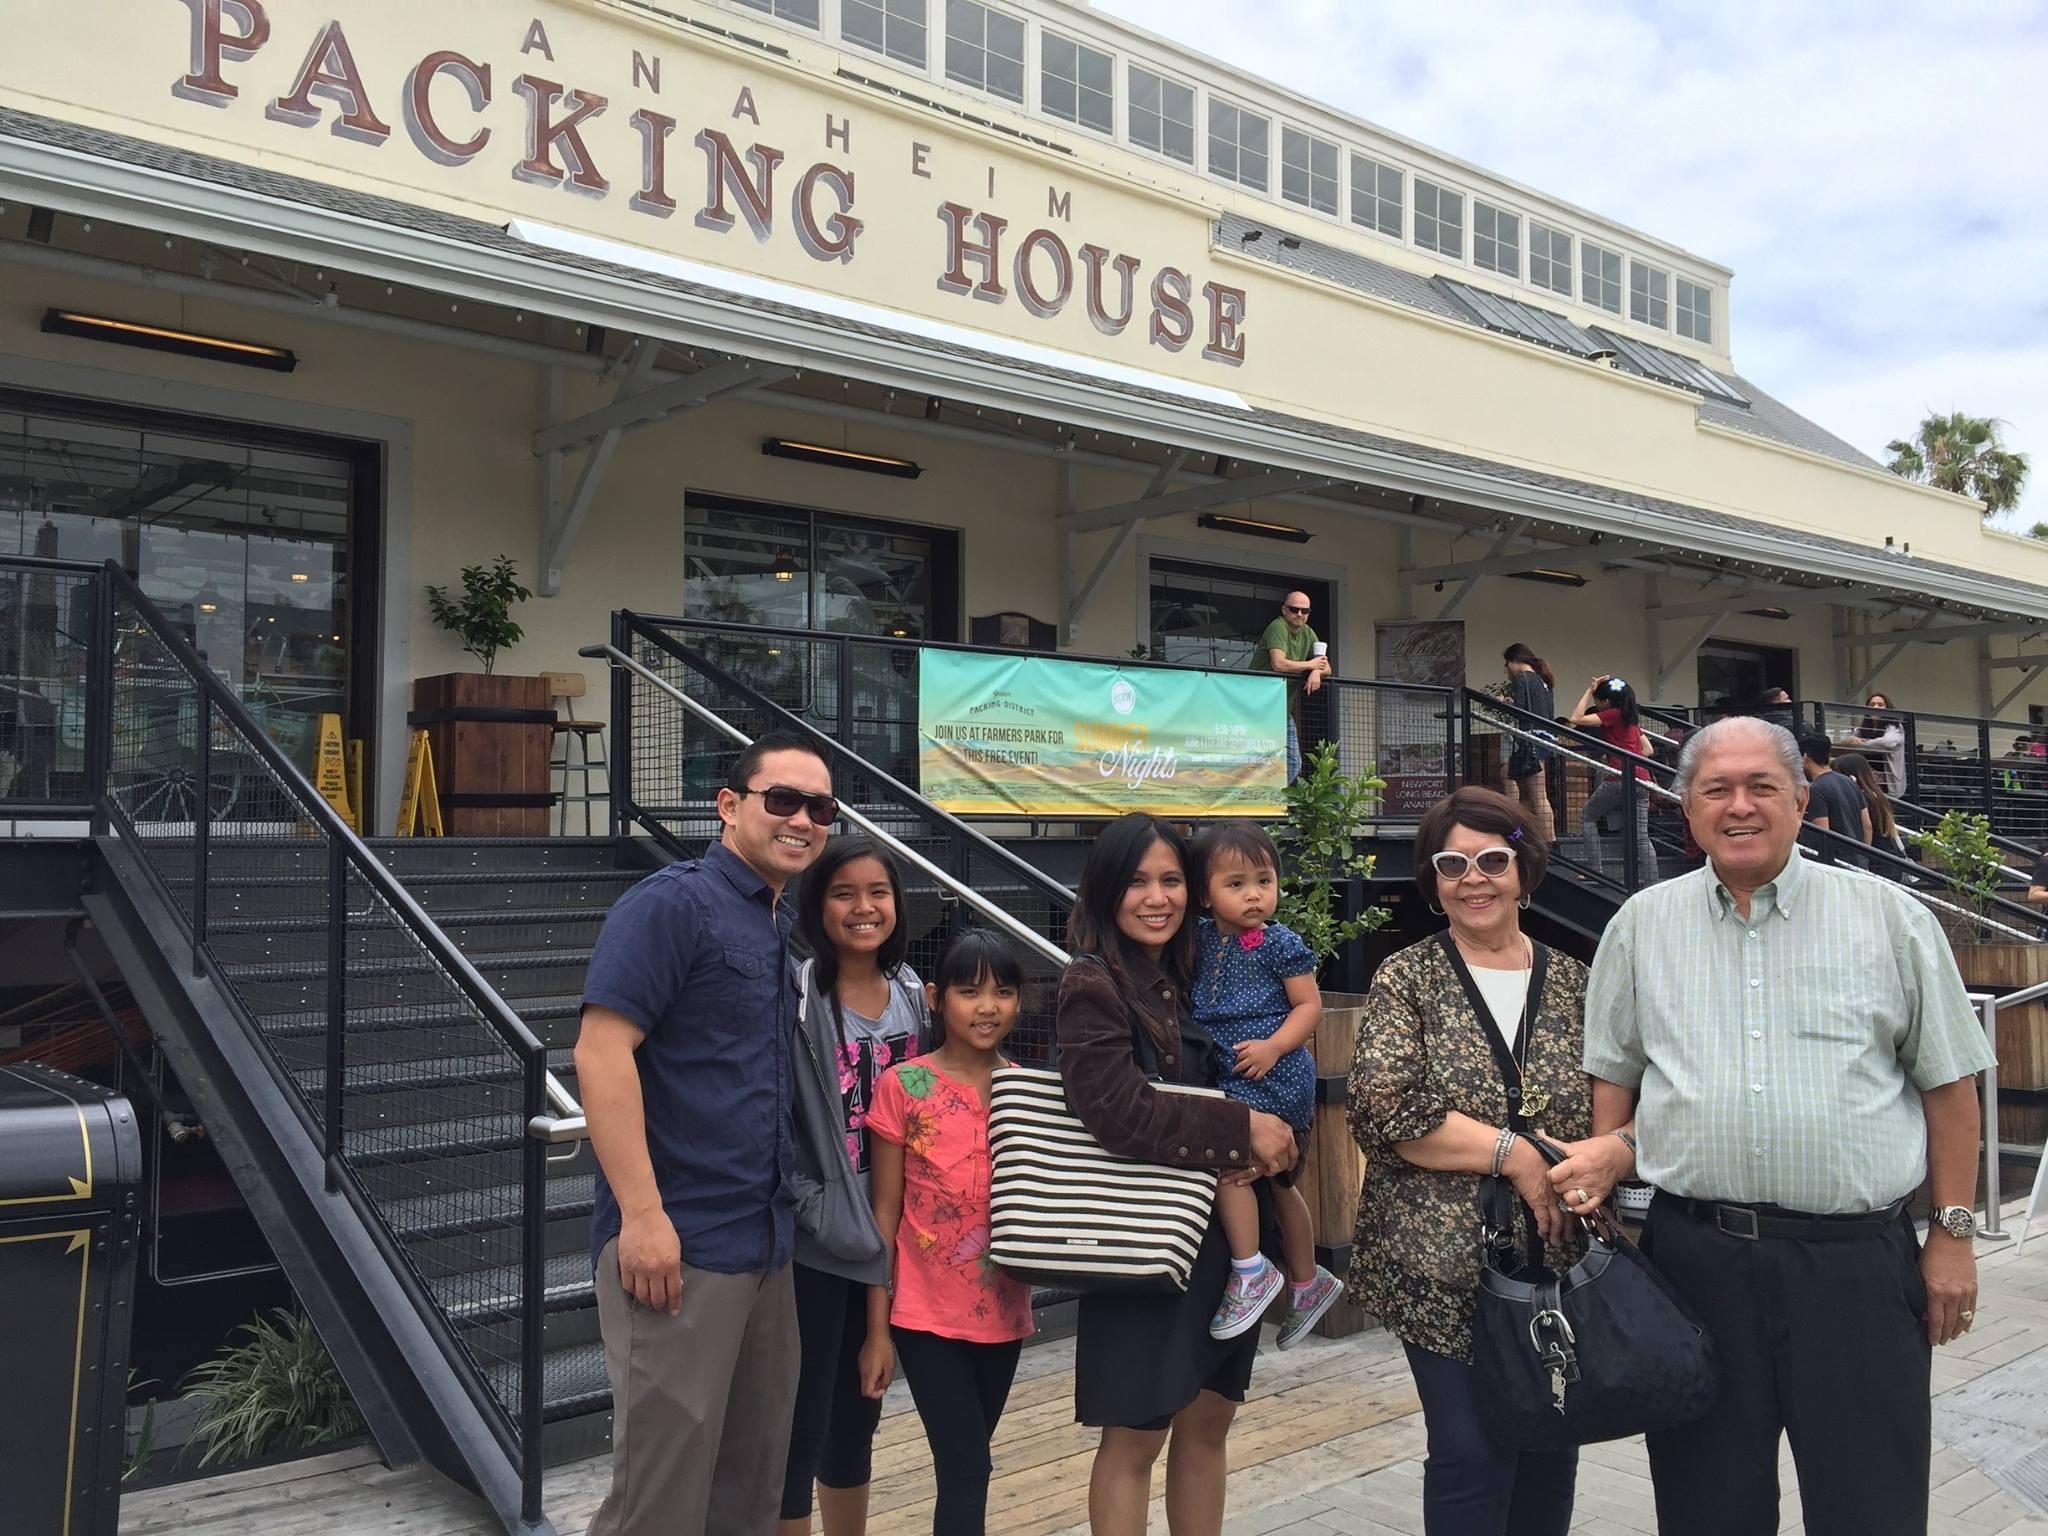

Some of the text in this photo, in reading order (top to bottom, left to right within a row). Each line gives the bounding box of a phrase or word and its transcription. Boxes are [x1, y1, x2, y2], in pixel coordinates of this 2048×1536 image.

[520, 18, 1071, 223] ANAHEIM
[171, 0, 1247, 368] PACKING HOUSE
[969, 700, 1035, 717] PACKING DISTRICT
[934, 725, 1065, 744] JOIN US AT FARMERS PARK FOR
[963, 748, 1038, 764] THIS FREE EVENT!
[1098, 740, 1178, 790] Nights
[1401, 780, 1444, 789] NEWPORT
[1395, 790, 1449, 799] LONG BEAC
